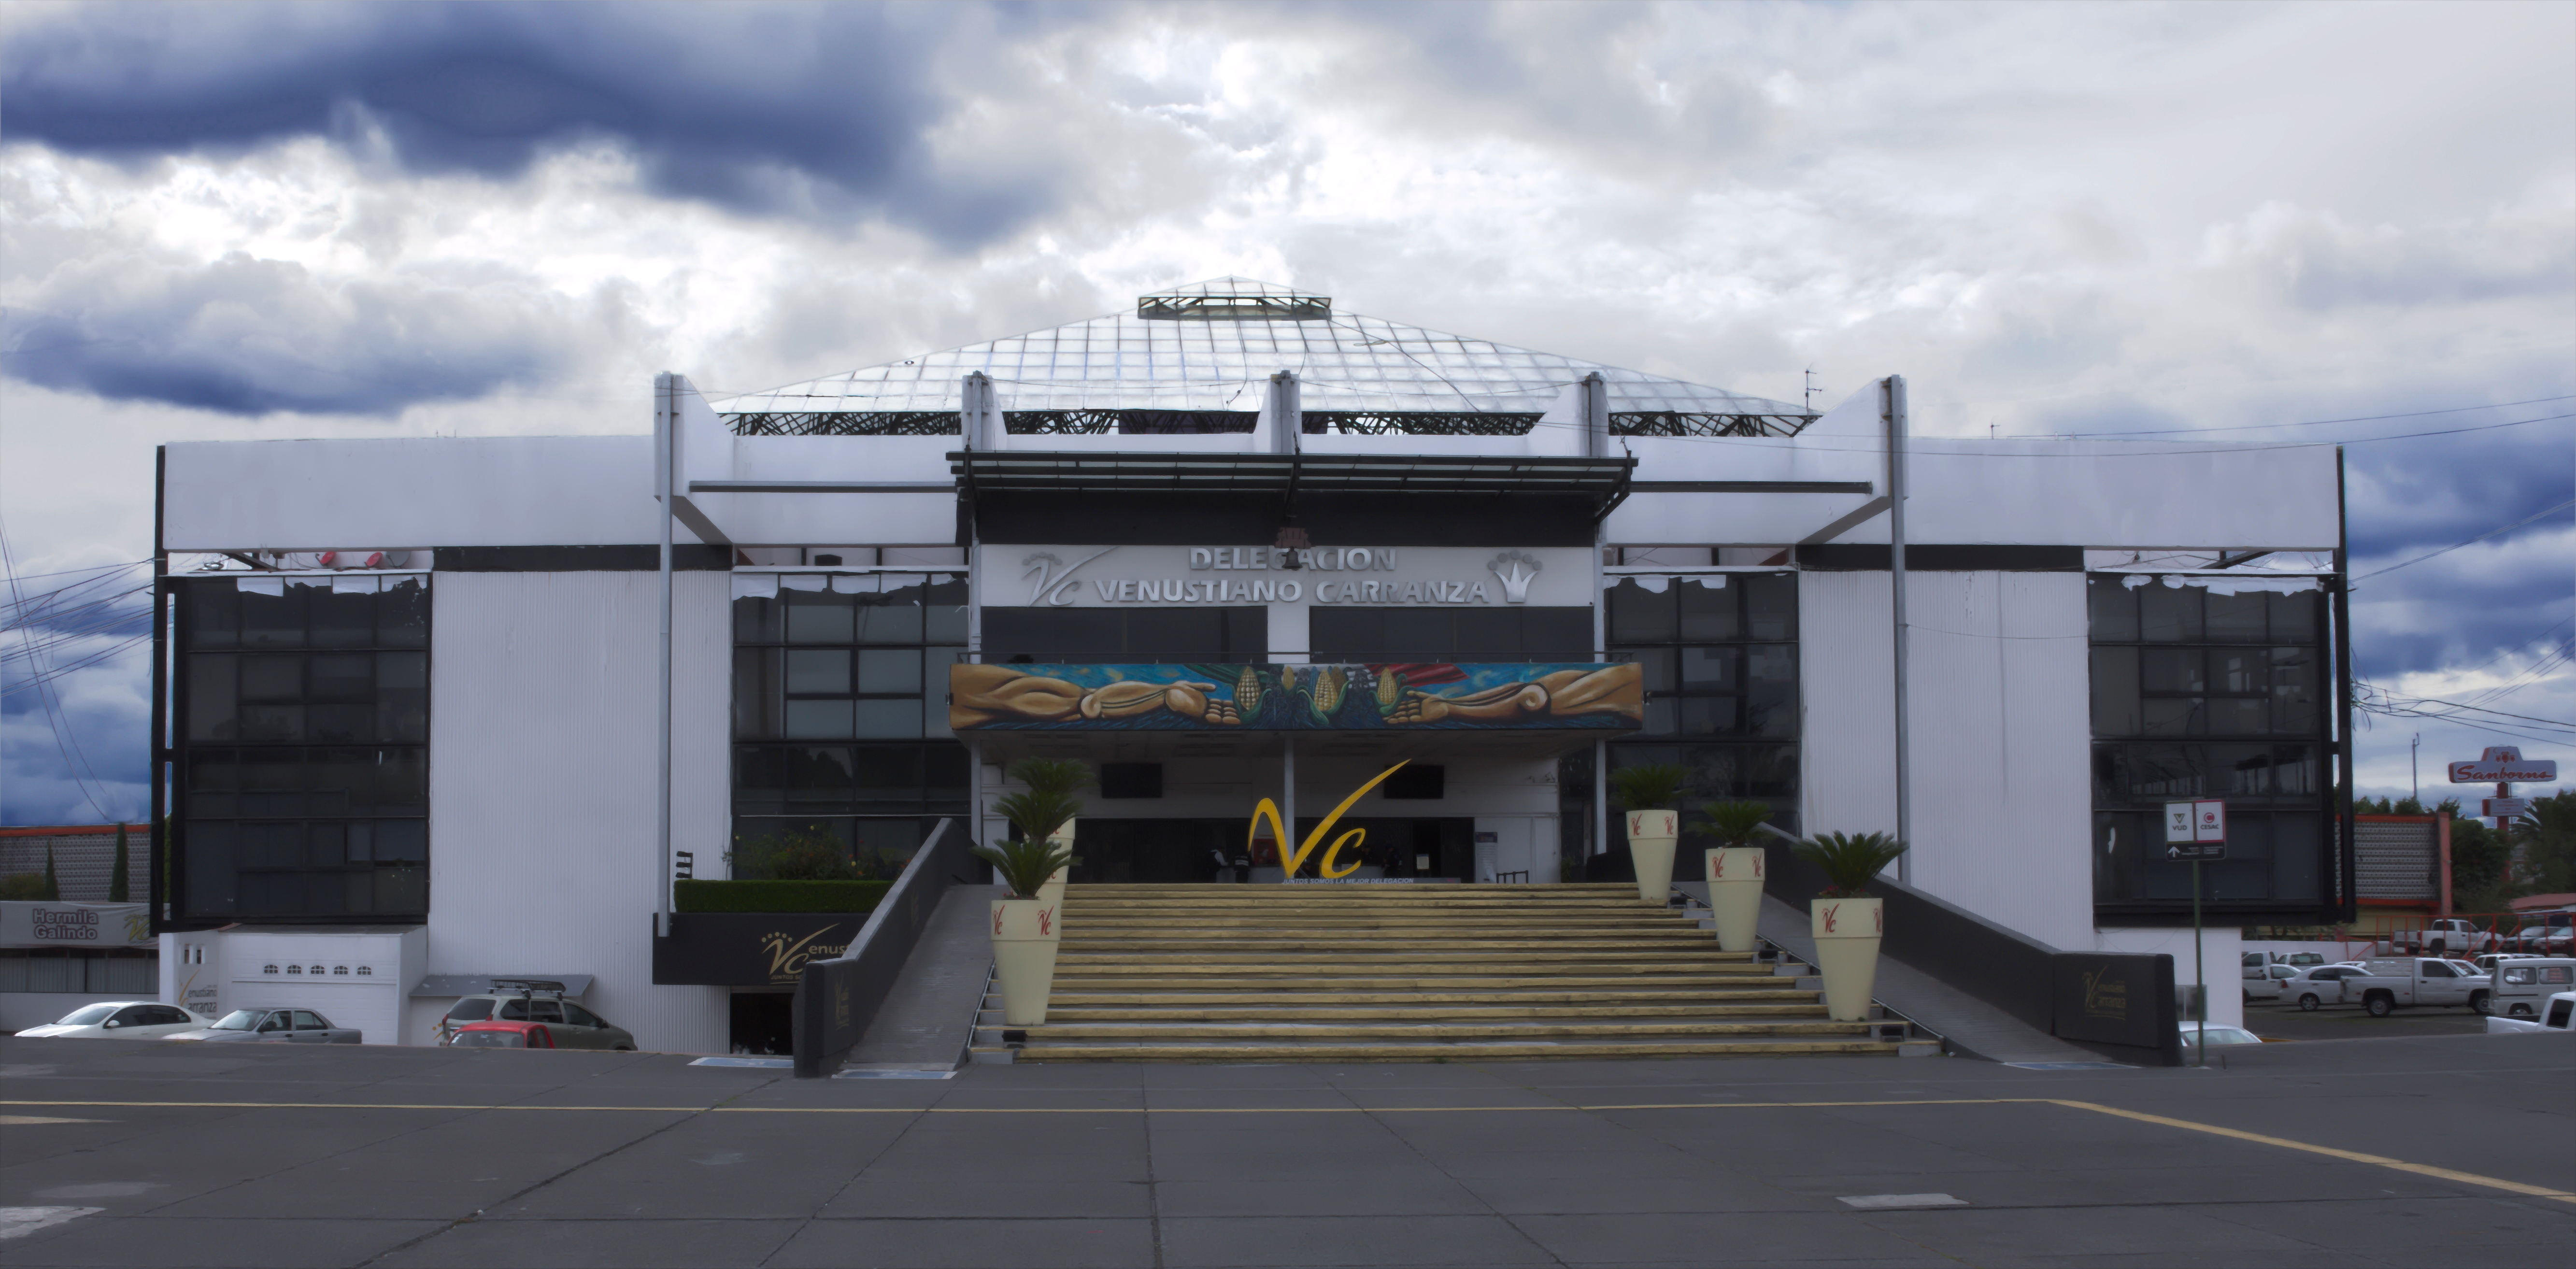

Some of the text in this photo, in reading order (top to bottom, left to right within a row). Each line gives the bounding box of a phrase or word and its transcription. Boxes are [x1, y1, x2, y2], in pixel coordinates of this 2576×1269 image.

[1094, 579, 1490, 603] VENUSTIANO CARRANZA
[2457, 765, 2554, 780] Sanborns
[33, 909, 99, 925] Hermila
[34, 925, 98, 940] Galindo
